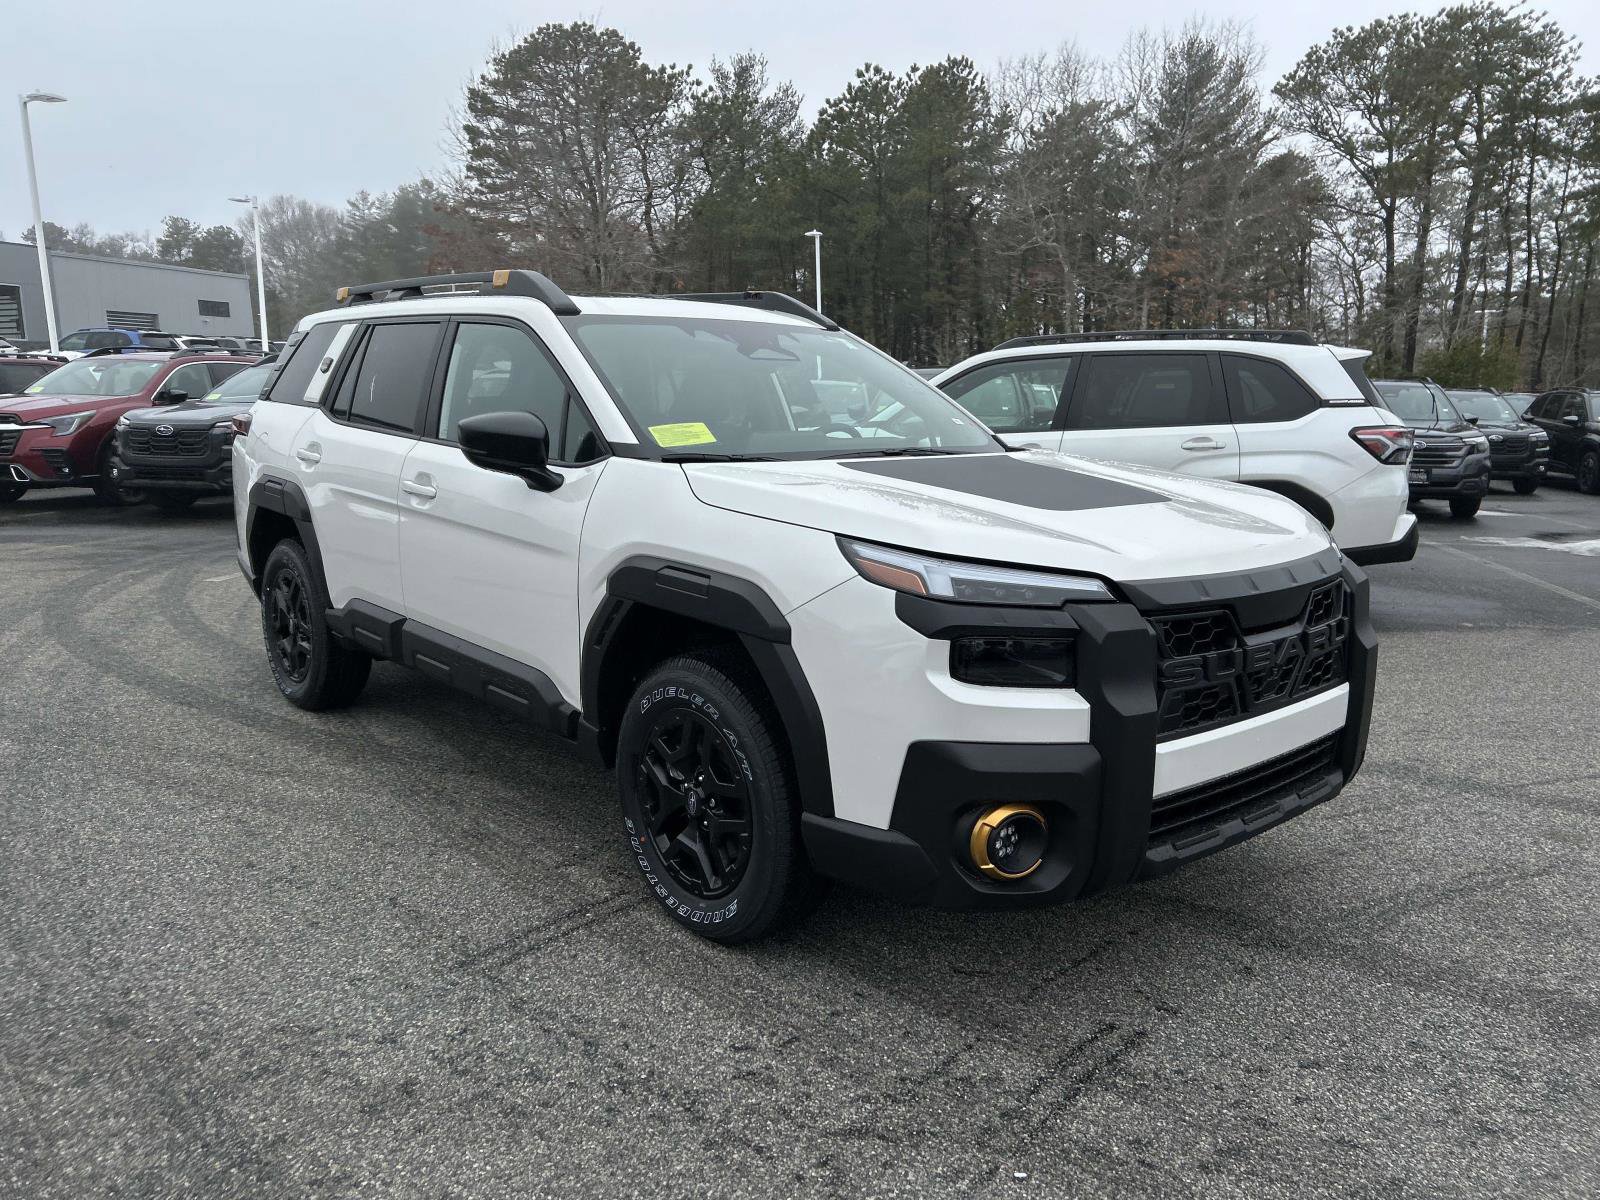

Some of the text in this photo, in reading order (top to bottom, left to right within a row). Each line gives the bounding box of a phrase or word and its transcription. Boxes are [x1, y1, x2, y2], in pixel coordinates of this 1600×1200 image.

[1160, 616, 1350, 684] SUBARU
[640, 686, 719, 721] DUELER
[624, 817, 738, 923] BRIDGESTONE
